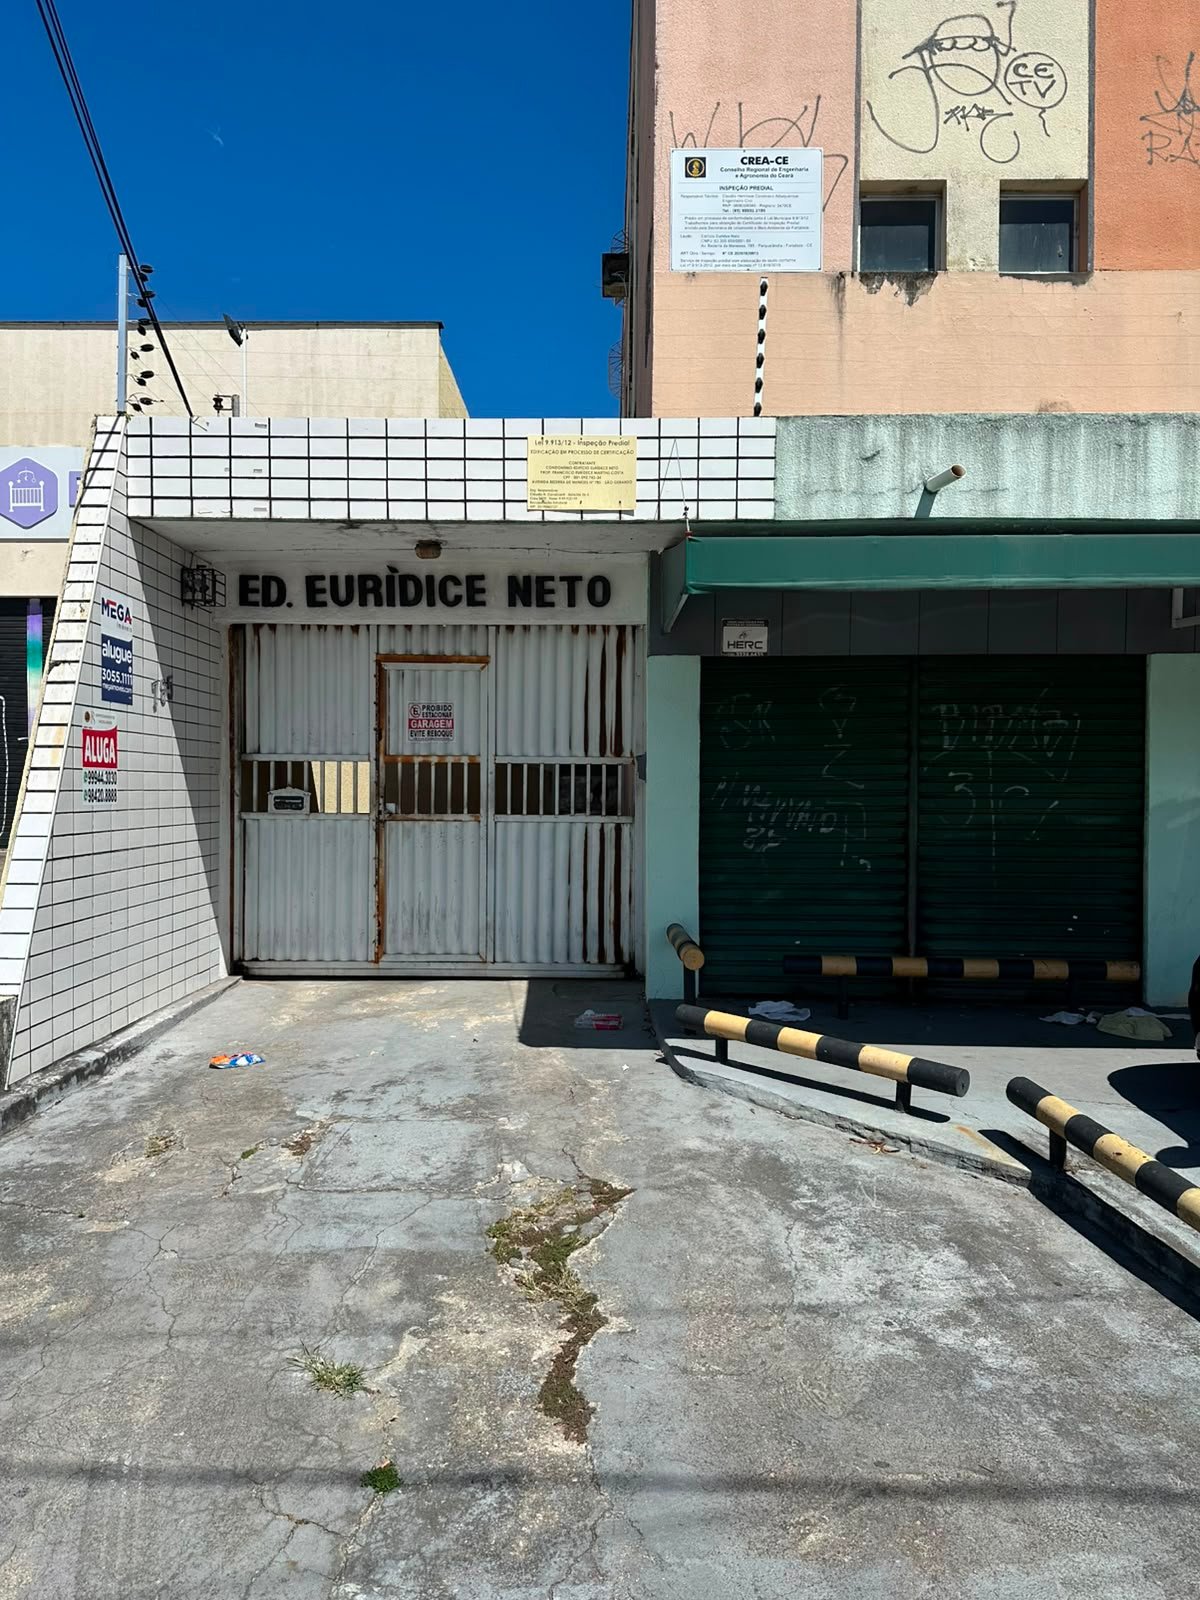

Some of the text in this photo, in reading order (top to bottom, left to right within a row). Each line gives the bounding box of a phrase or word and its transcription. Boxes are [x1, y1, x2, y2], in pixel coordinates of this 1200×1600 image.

[740, 156, 790, 166] CREA-CE
[238, 574, 293, 608] ED.
[507, 575, 611, 608] NETO
[101, 597, 132, 625] MEGA
[102, 639, 132, 664] alugue
[727, 641, 763, 649] HERC
[102, 668, 133, 685] 3055.1111
[411, 720, 453, 728] GARAGEM
[410, 730, 453, 738] EVITE REBOQUE
[84, 735, 115, 764] ALUGA
